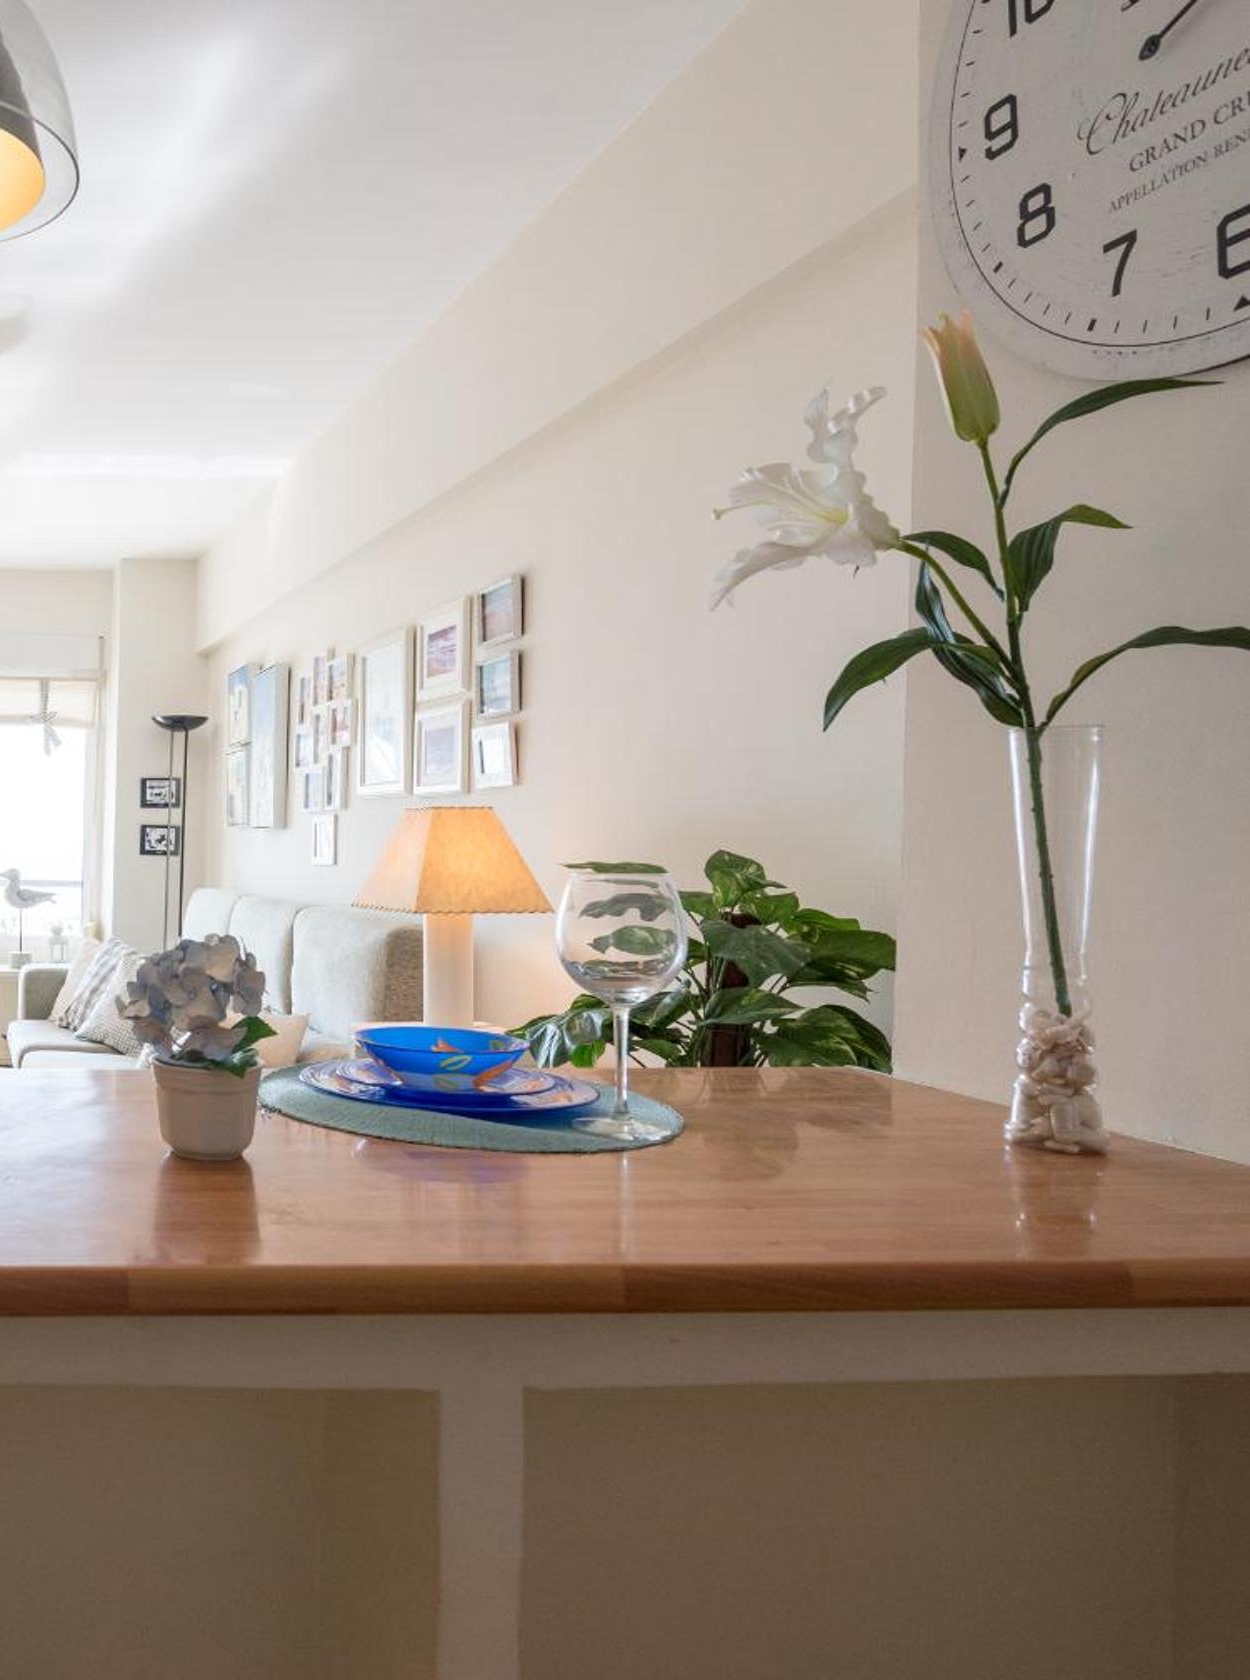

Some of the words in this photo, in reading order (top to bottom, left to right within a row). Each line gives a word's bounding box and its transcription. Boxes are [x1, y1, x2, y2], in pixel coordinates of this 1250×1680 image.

[984, 94, 1019, 160] 9
[1076, 47, 1250, 156] Chateaune
[1129, 119, 1206, 173] GRAND
[1213, 91, 1250, 125] CR
[1017, 183, 1055, 248] 8
[1108, 151, 1209, 214] APPELLATION
[1103, 229, 1137, 297] 7
